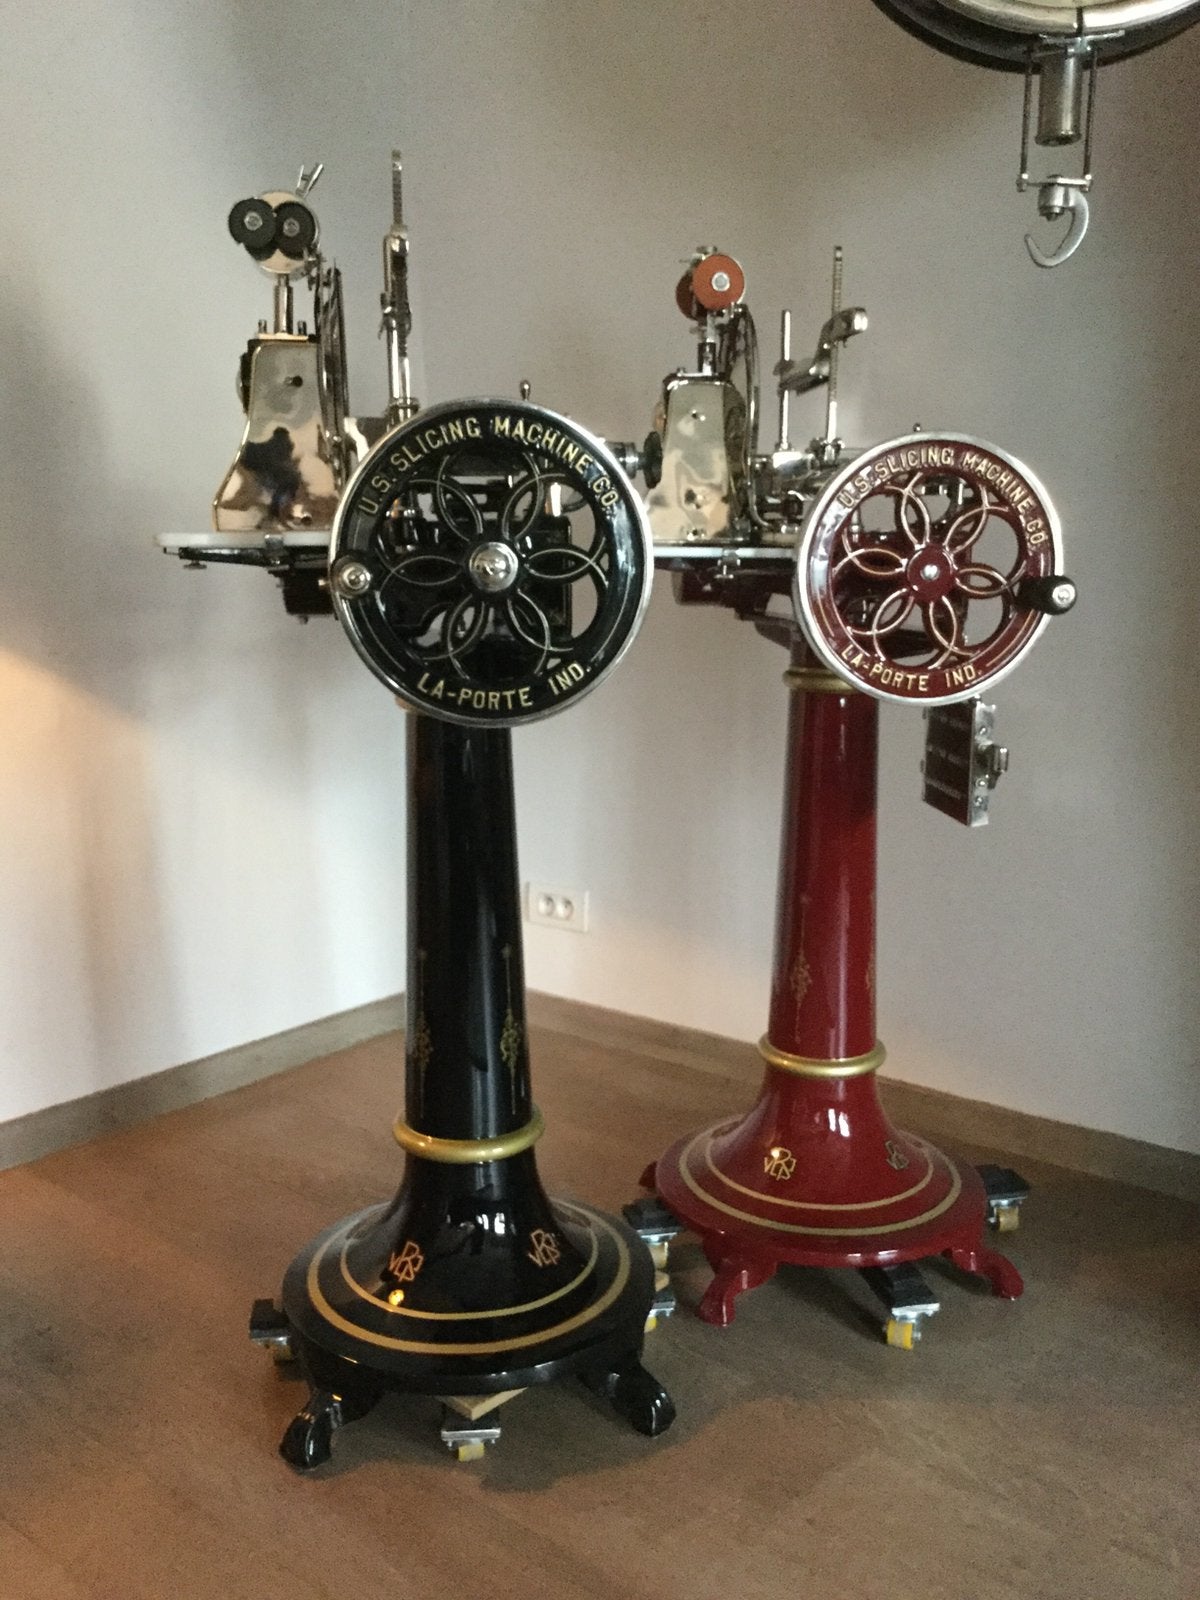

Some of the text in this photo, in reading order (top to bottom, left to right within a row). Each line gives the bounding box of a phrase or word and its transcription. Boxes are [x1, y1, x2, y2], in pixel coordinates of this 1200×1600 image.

[390, 417, 482, 472] SLICING
[494, 415, 594, 475] MACHINE
[874, 446, 955, 479] SLICING
[962, 451, 1034, 514] MACHINE
[416, 661, 591, 711] LA-PORTE IND.
[841, 644, 982, 692] LA-PORTE IND.
